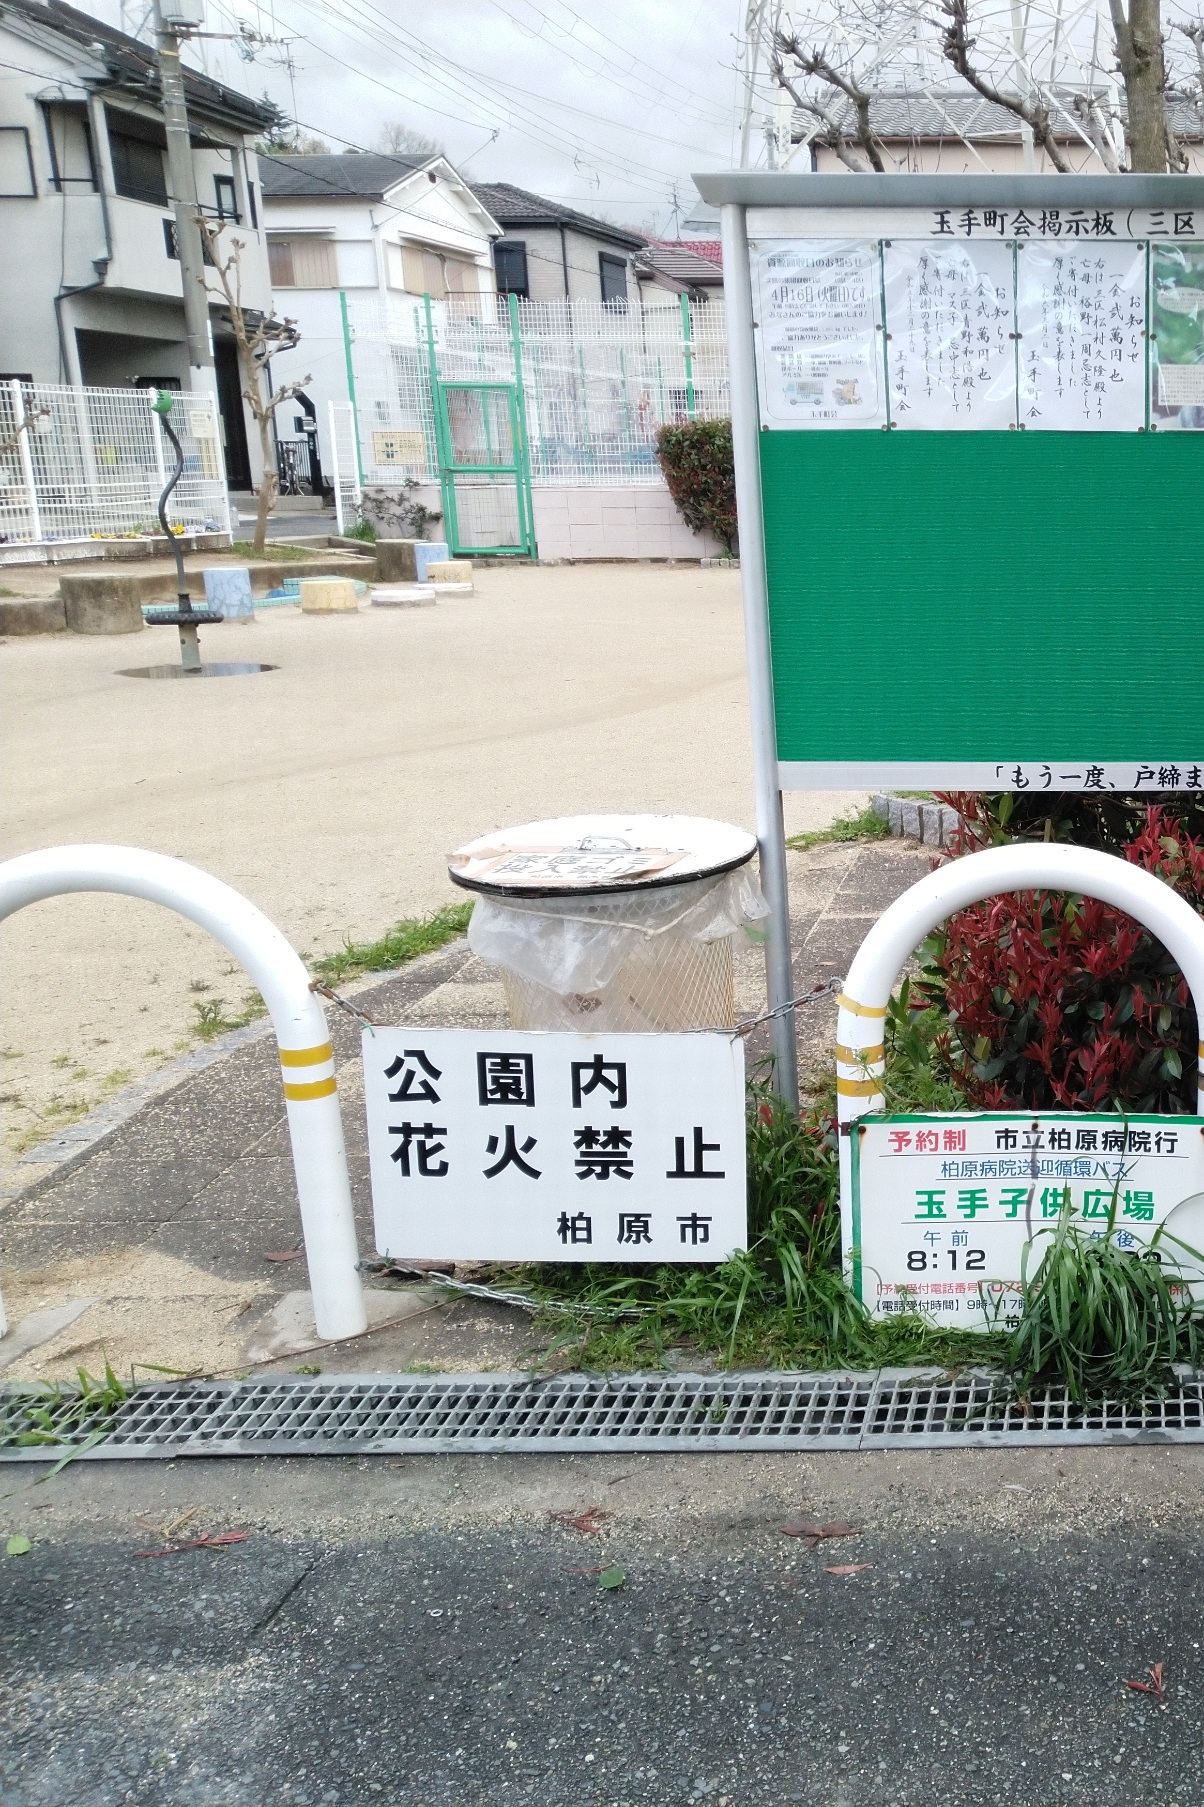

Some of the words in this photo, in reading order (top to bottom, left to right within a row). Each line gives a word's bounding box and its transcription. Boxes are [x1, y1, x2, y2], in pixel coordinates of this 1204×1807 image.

[917, 256, 933, 398] 厚く感謝の意を表します
[990, 287, 1010, 355] お知らせ
[1052, 255, 1067, 399] 厚く感謝の意を表します
[1066, 255, 1079, 388] ご寄付いただきました
[1125, 295, 1144, 363] お知らせ
[894, 349, 912, 412] 玉手町会
[1026, 349, 1042, 418] 玉手町会
[492, 864, 637, 874] 投入禁止
[508, 855, 653, 865] 家庭ゴミ
[383, 1049, 629, 1109] 公園内
[387, 1122, 726, 1181] 花火禁止
[888, 1129, 967, 1153] 予約制
[994, 1127, 1179, 1154] 市立柏原病院行
[940, 1159, 1128, 1178] 柏原病院送迎循環バス
[556, 1211, 713, 1246] 柏原市
[914, 1186, 1155, 1221] 玉手子供広場
[906, 1249, 986, 1272] 8:12
[923, 1230, 969, 1247] 午前
